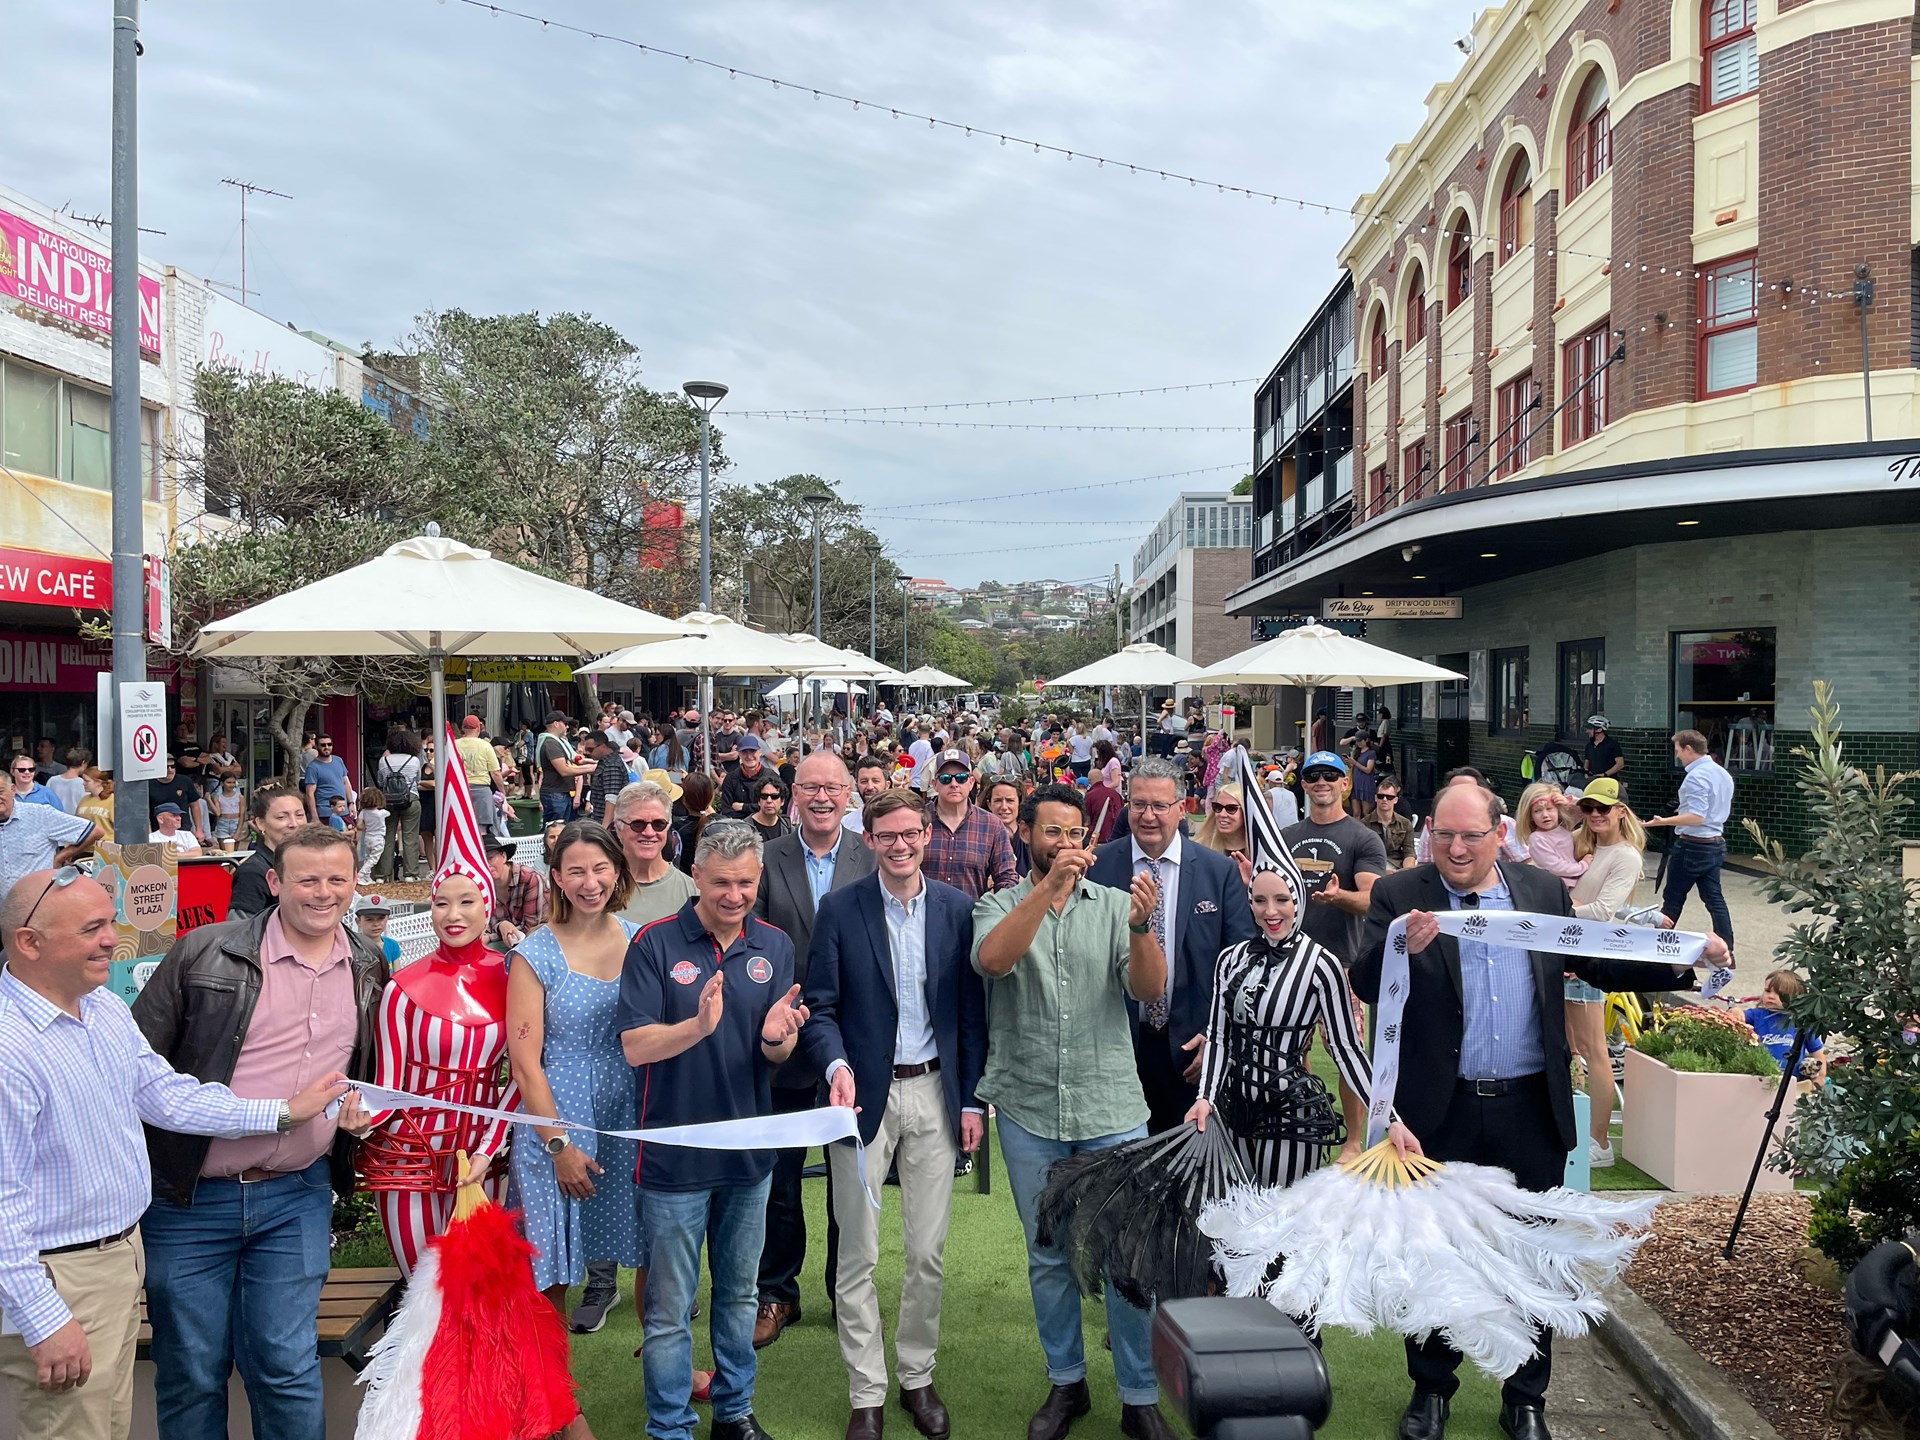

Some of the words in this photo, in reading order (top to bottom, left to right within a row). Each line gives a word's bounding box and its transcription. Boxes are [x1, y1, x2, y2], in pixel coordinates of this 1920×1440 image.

[38, 231, 112, 274] MAROUBRA
[17, 236, 159, 335] INDIN
[18, 283, 76, 317] DELIGHT
[79, 307, 159, 350] RESTANT
[37, 569, 96, 599] CAFÉ
[1329, 600, 1350, 613] The
[1352, 600, 1375, 615] Bay
[482, 663, 515, 676] FRESH
[532, 665, 562, 676] JUICY
[131, 882, 167, 894] MCKEON
[133, 893, 165, 905] STREET
[136, 905, 163, 916] PLAZA
[1461, 927, 1485, 936] NSW
[1557, 936, 1581, 945] NSW
[1656, 944, 1681, 954] NSW
